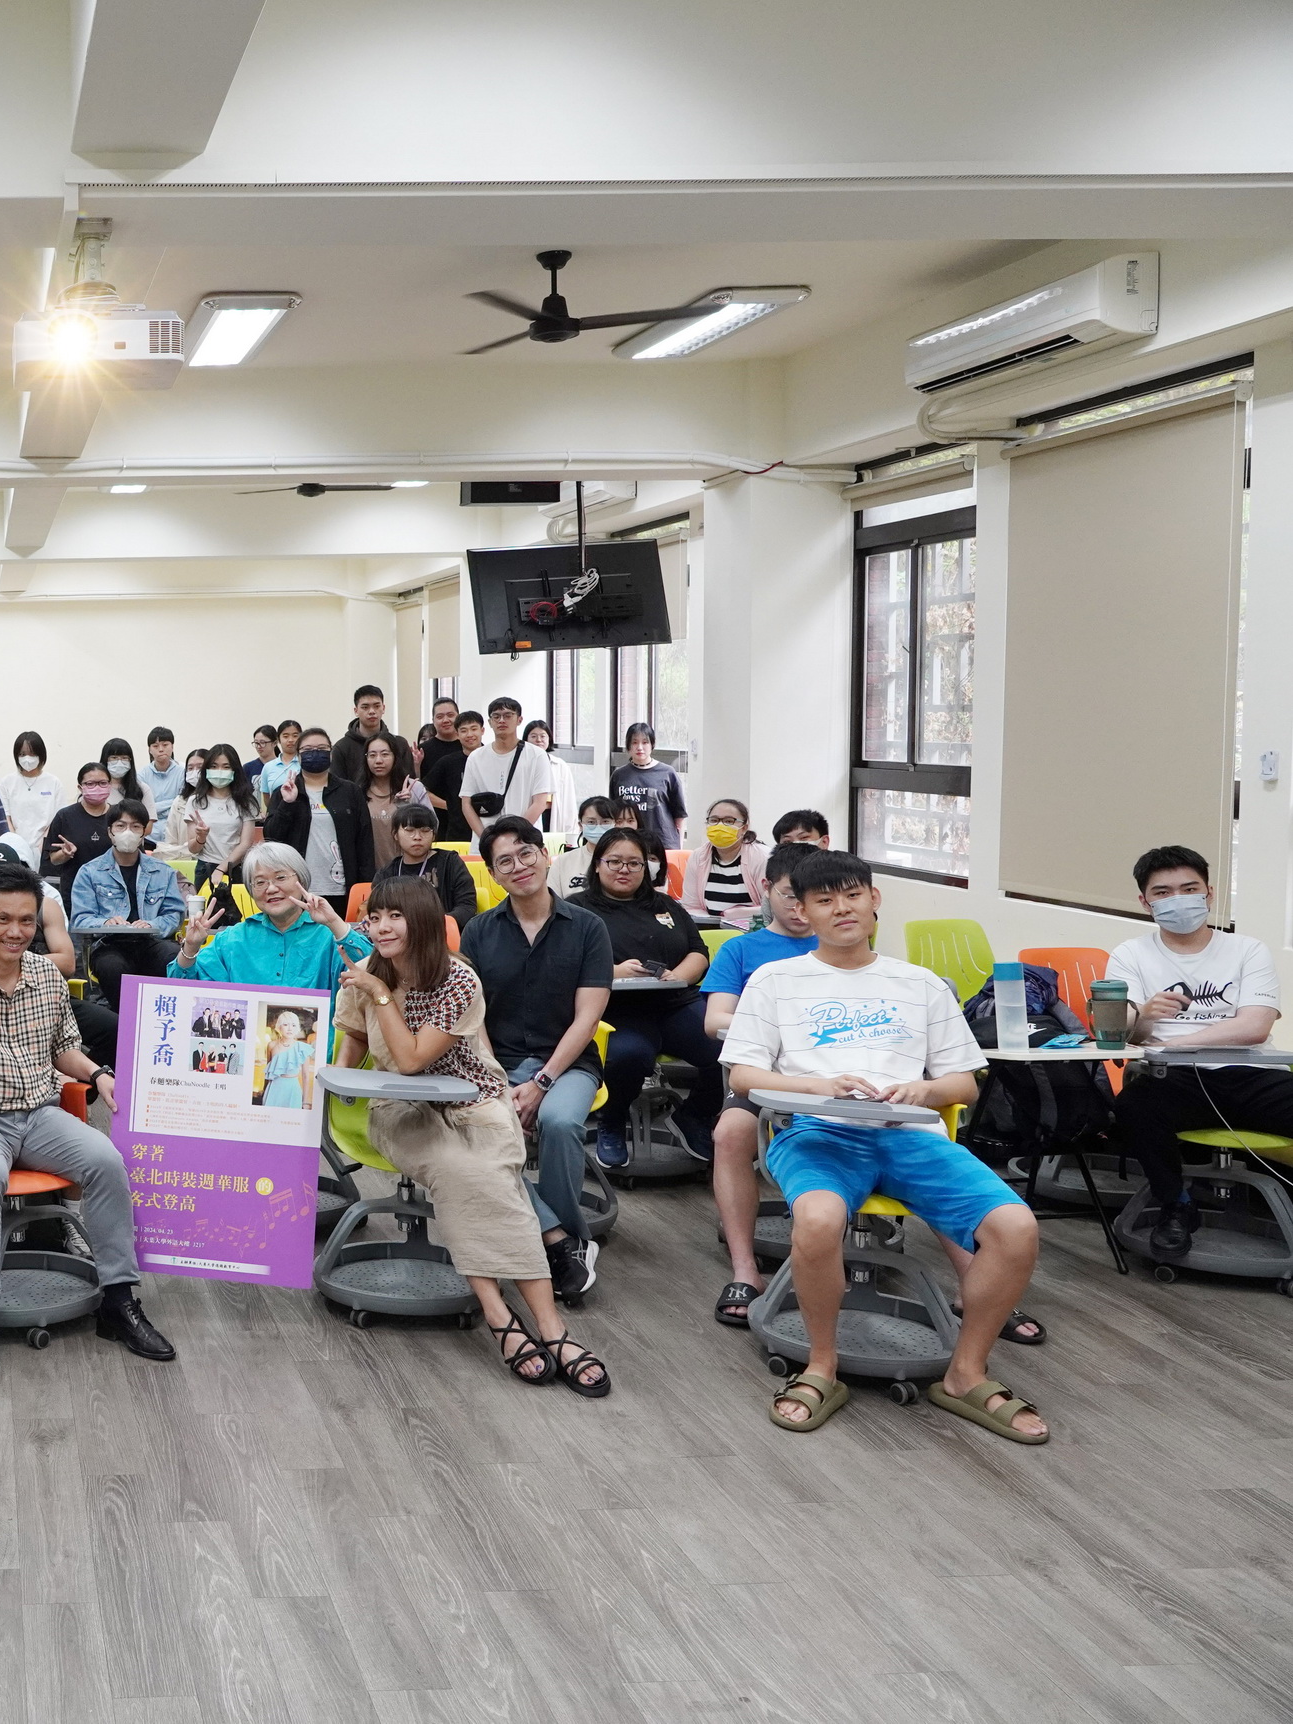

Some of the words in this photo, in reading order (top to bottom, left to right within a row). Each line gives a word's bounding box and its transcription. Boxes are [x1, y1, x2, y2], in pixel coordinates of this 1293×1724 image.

[618, 785, 647, 796] Better
[810, 1001, 887, 1036] Perfect
[153, 994, 177, 1067] 賴予喬
[838, 1034, 855, 1043] cut
[869, 1027, 902, 1038] choose
[215, 1083, 227, 1091] 主唱
[131, 1143, 165, 1162] 穿著
[129, 1167, 250, 1193] 臺北時裝週華服
[258, 1179, 271, 1193] 的
[131, 1190, 196, 1213] 客式登高
